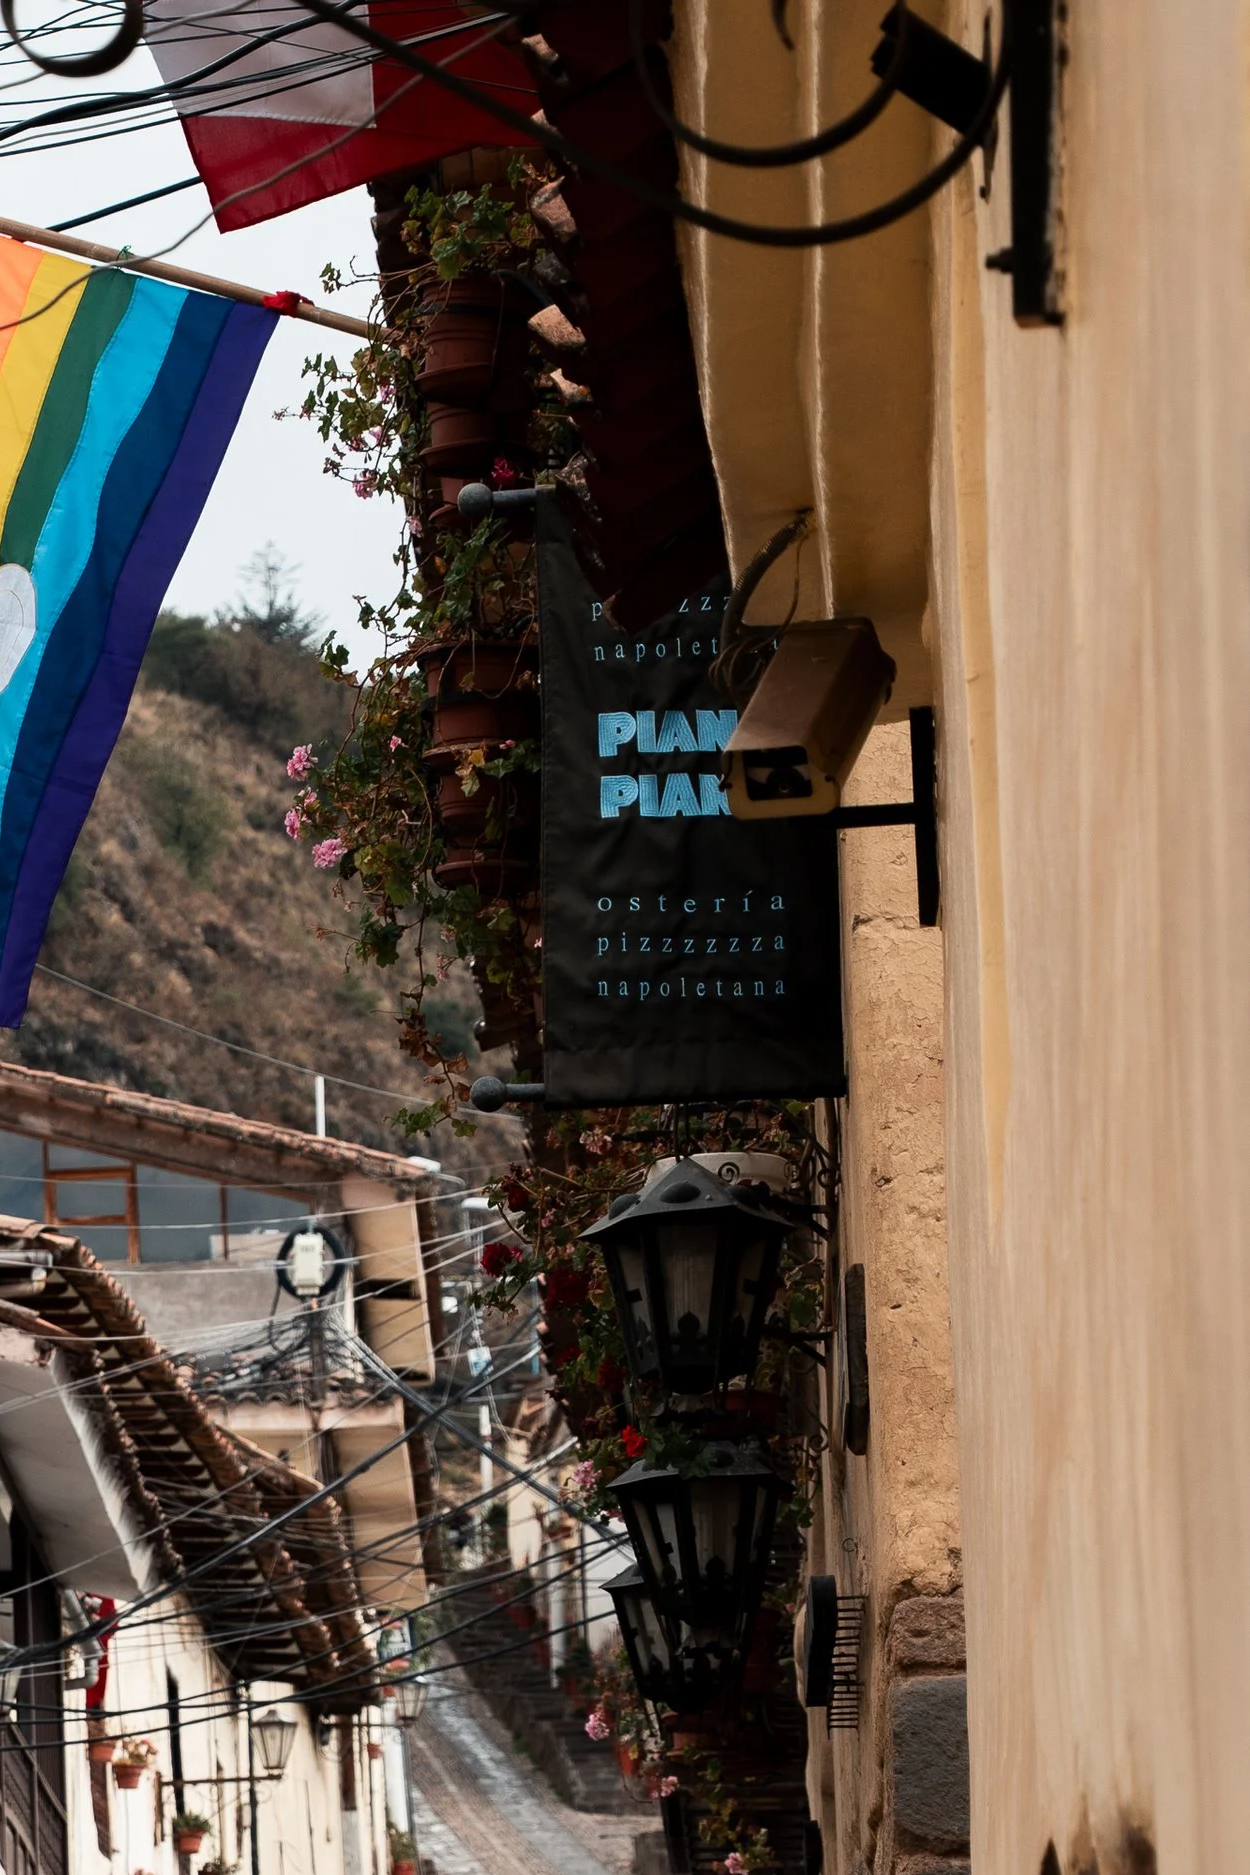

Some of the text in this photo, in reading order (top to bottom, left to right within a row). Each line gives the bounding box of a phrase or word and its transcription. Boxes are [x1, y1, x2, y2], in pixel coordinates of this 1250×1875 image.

[598, 709, 738, 757] PIAN
[601, 772, 732, 819] PIAN
[598, 889, 785, 913] ostería
[597, 931, 785, 957] pizzzzzza
[597, 976, 785, 1001] napoletana
